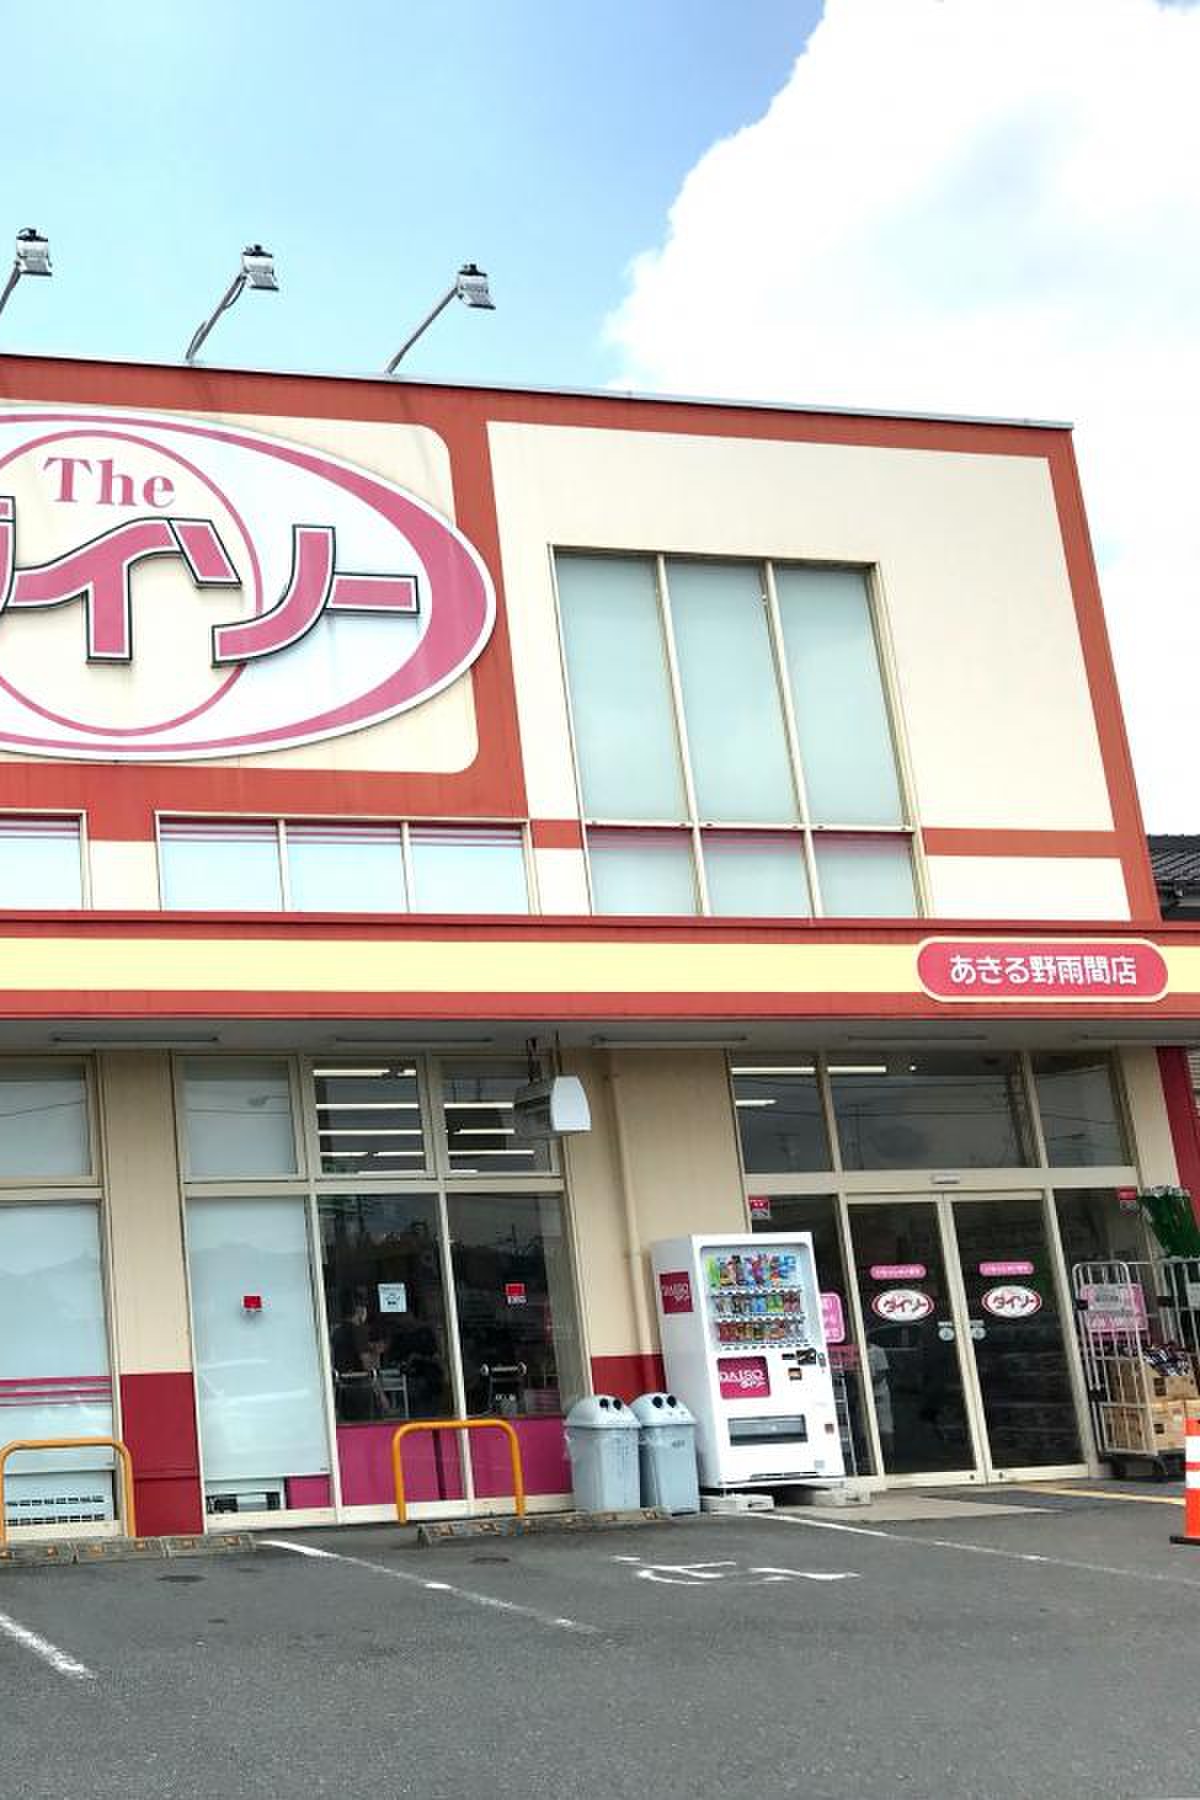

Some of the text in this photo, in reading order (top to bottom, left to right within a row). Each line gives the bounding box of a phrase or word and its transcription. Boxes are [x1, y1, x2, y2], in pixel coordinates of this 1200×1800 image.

[42, 456, 176, 509] The
[950, 955, 1137, 985] あきる野雨間店
[883, 1299, 927, 1313] ダイソー
[993, 1295, 1035, 1309] ダイソー
[720, 1369, 765, 1383] DAISO
